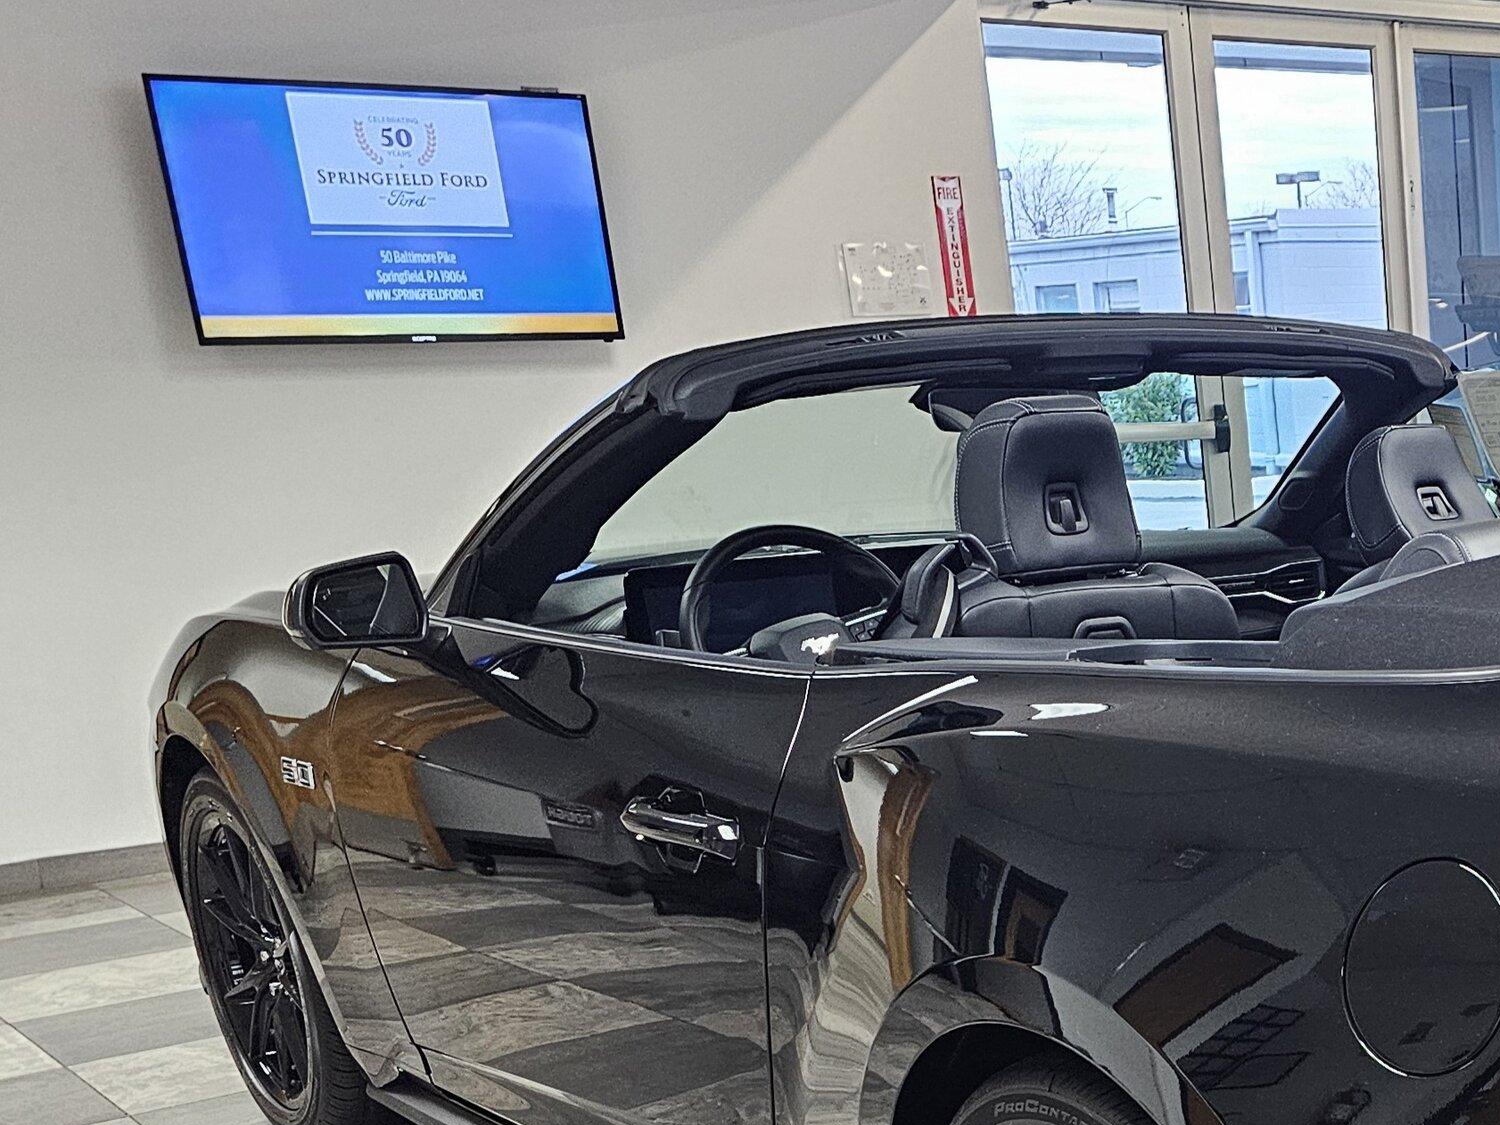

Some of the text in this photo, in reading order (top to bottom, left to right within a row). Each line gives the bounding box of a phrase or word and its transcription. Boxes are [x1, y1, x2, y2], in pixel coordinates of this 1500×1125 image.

[381, 127, 413, 148] 50
[317, 169, 488, 188] SPRINGFIELD FORD
[387, 190, 428, 208] Ford
[937, 186, 959, 200] FIRE
[380, 250, 457, 264] 50 Baltimore Pike
[946, 206, 968, 313] EXTINGUISHER
[427, 271, 440, 283] PA
[440, 270, 467, 283] 19064
[365, 288, 484, 301] WWW.SPRINGFIELDFORD.NET
